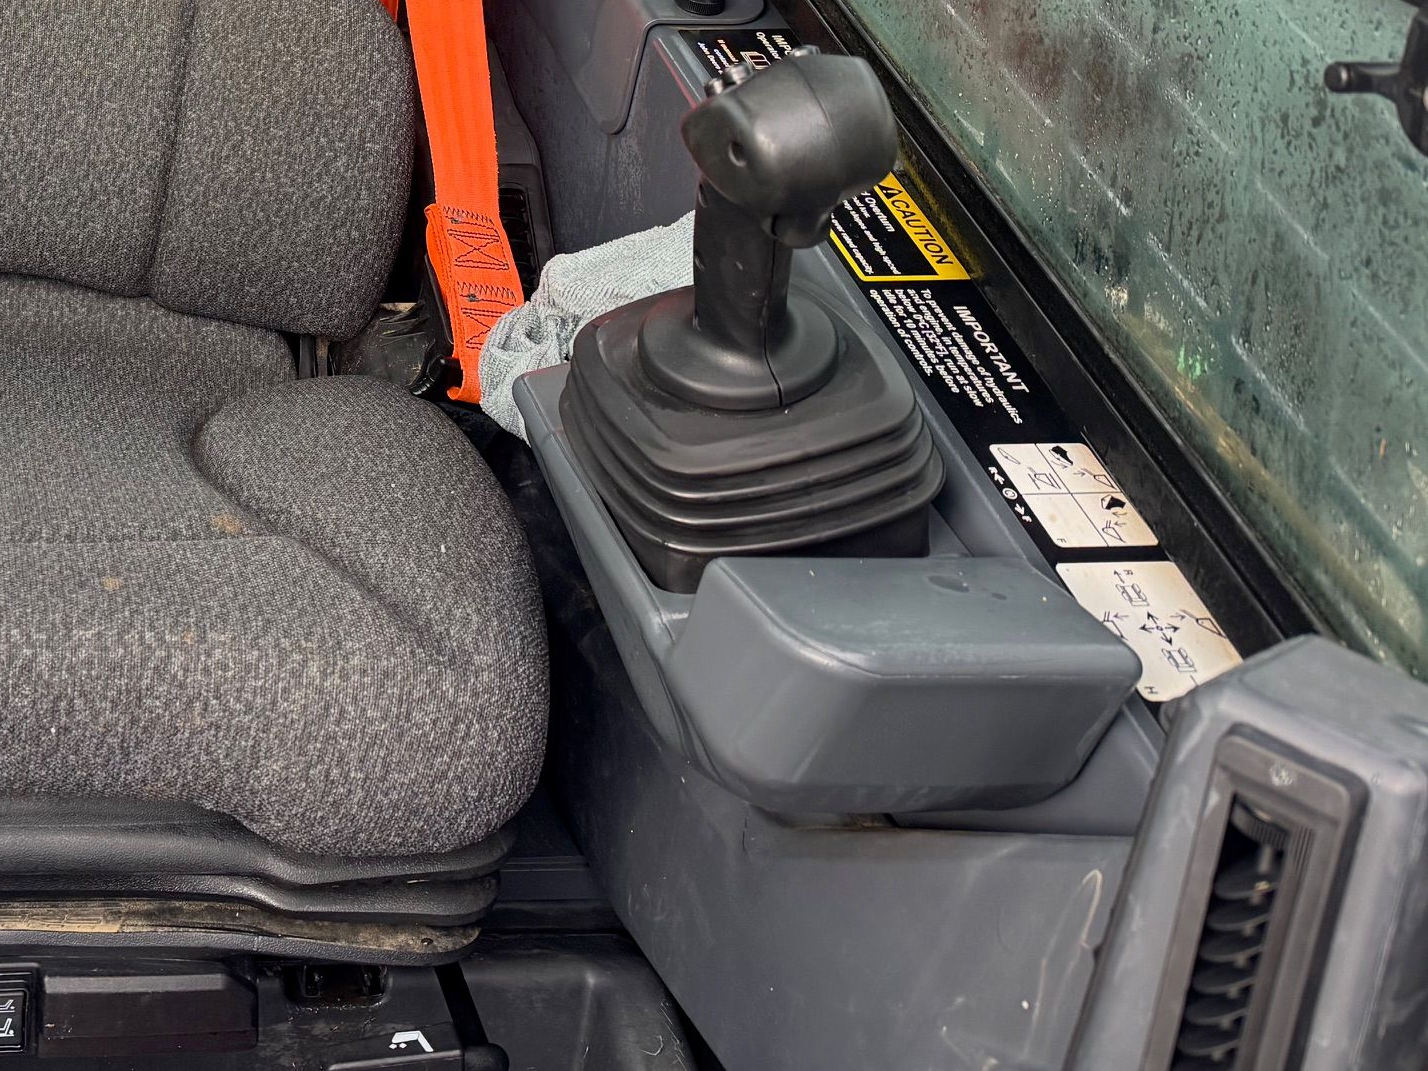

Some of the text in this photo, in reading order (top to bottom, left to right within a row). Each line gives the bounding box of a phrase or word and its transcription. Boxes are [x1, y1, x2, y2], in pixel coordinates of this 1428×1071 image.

[756, 32, 781, 59] Operator
[864, 197, 895, 232] Overturn
[891, 199, 953, 265] CAUTION
[872, 242, 886, 255] high
[920, 288, 932, 299] To
[925, 300, 956, 331] prevent
[869, 289, 901, 327] operation
[904, 338, 933, 376] controls.
[881, 289, 897, 304] idle
[893, 305, 907, 317] for
[910, 330, 939, 363] minutes
[935, 365, 960, 393] before
[894, 289, 917, 313] below
[944, 358, 960, 374] run
[963, 385, 984, 407] slow
[906, 288, 925, 304] and
[919, 305, 943, 336] engine,
[948, 346, 994, 403] temperatures
[951, 331, 980, 365] damage
[953, 306, 1030, 393] IMPORTANT
[984, 377, 1023, 424] hydraulics
